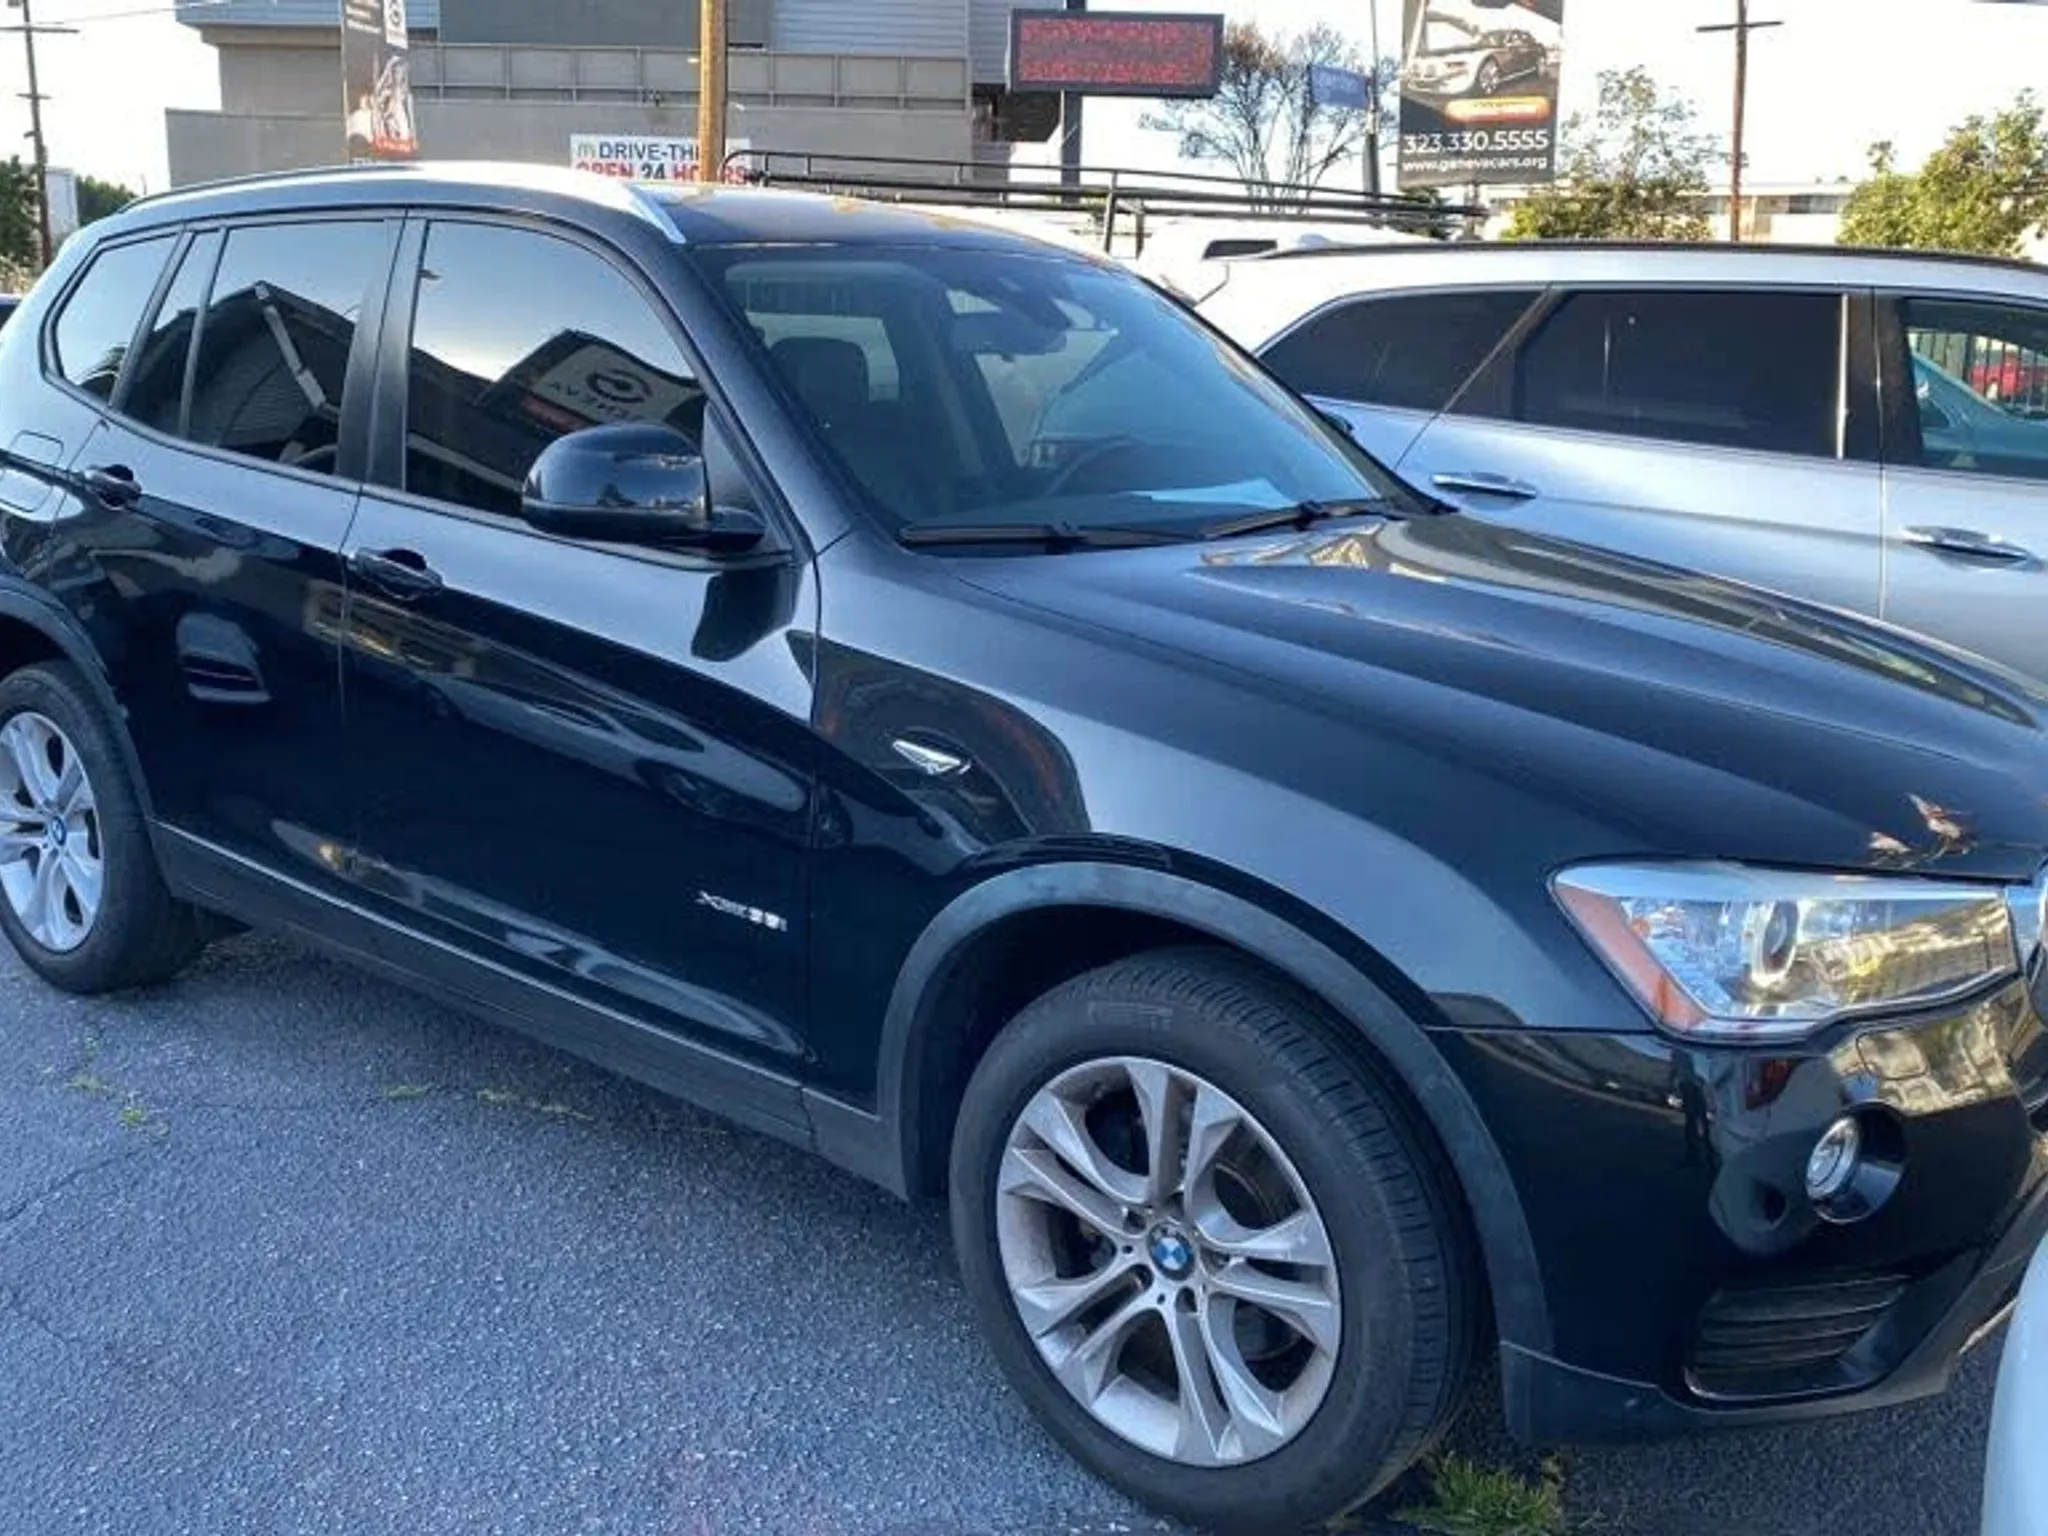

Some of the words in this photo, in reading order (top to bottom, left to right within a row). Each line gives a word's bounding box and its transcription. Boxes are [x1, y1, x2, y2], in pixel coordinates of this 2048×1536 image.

[600, 142, 700, 161] DRIVE-TH
[1403, 129, 1549, 153] 323.330.5555
[641, 162, 665, 179] 24
[674, 163, 748, 184] HORS
